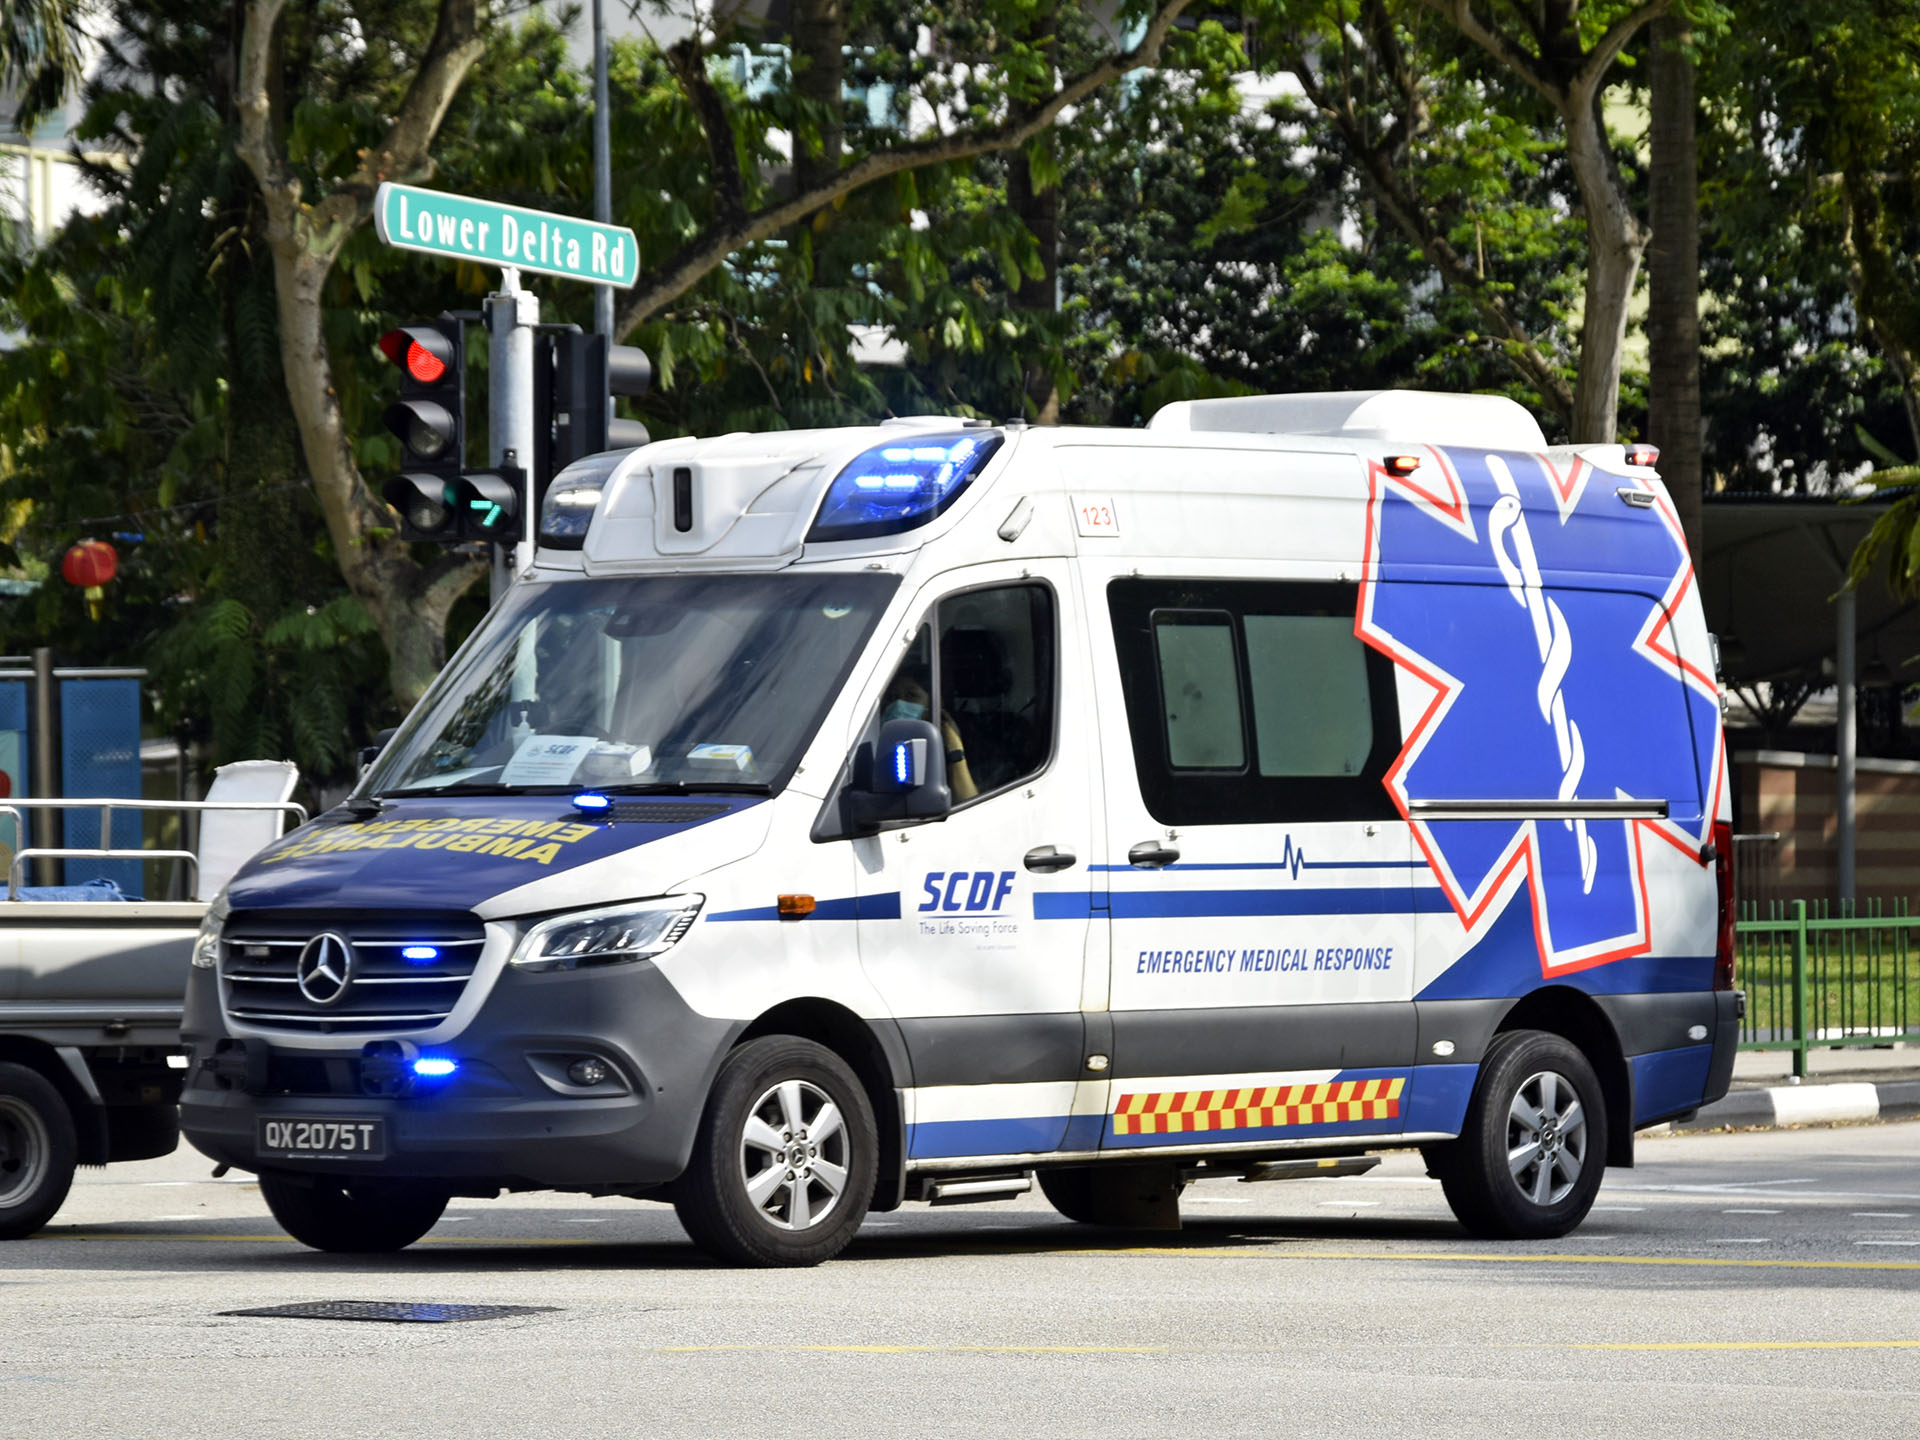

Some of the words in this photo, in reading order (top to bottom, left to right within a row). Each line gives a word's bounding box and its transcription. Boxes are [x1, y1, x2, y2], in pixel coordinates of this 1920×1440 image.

[400, 195, 490, 252] Lower
[502, 214, 580, 270] Delta
[592, 231, 625, 278] Rd
[1082, 506, 1112, 526] 123
[918, 871, 1017, 912] SCDF
[919, 921, 936, 935] The
[939, 920, 955, 935] Life
[958, 921, 990, 937] Saving
[993, 920, 1018, 934] Force
[1137, 950, 1236, 974] EMERGENCY
[1239, 949, 1308, 972] MEDICAL
[1313, 947, 1393, 971] RESPONSE
[265, 1122, 374, 1151] QX2075T
